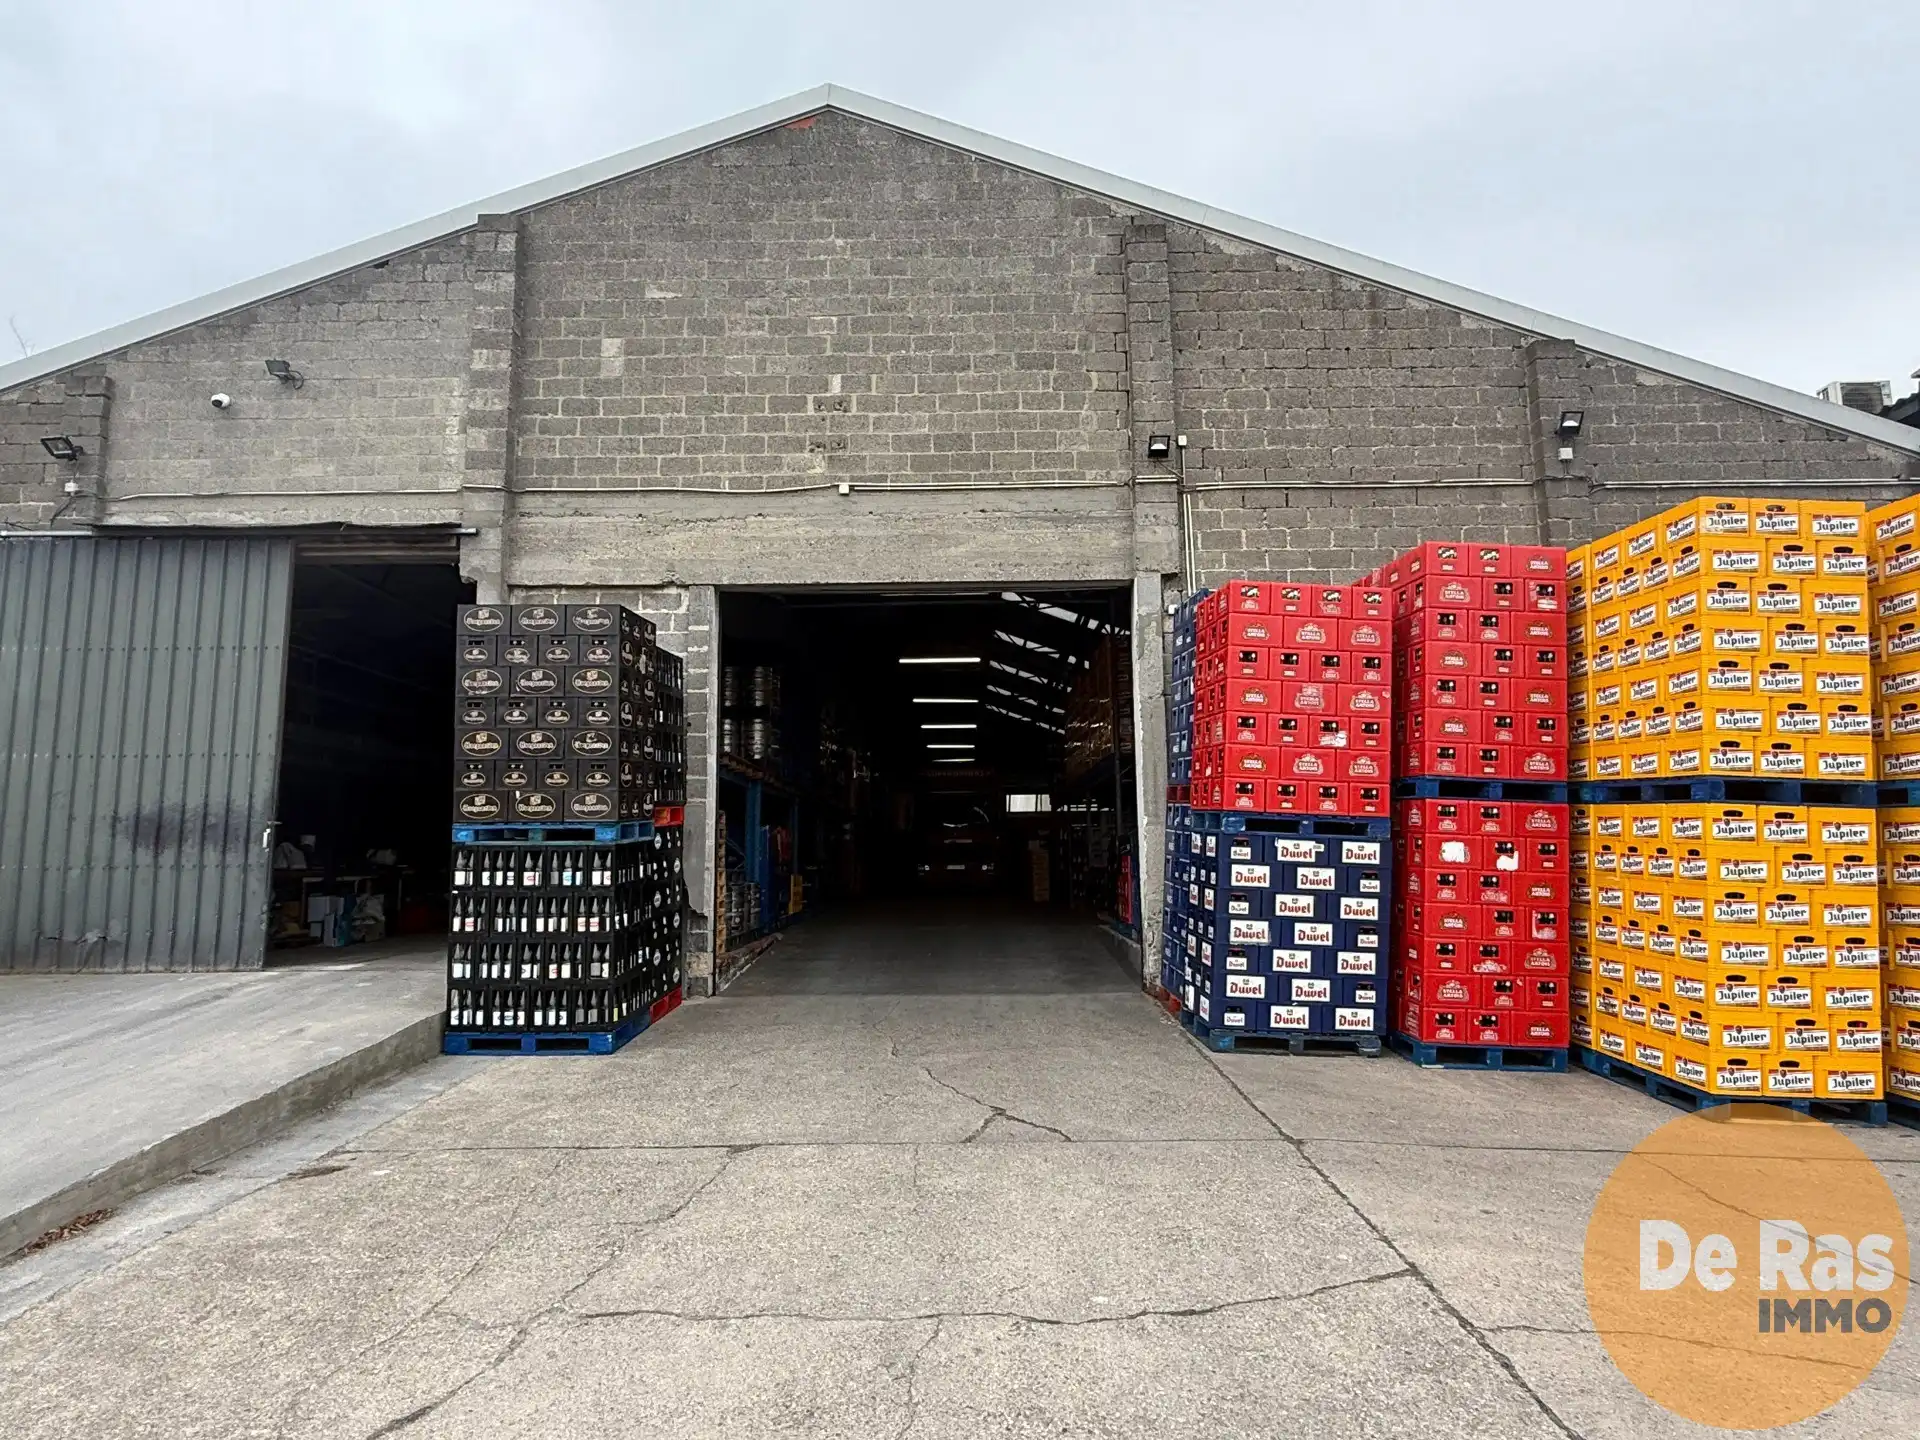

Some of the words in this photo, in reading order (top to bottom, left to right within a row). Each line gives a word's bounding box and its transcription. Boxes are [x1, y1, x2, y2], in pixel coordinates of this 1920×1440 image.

[1708, 517, 1746, 527] Jupiler
[1759, 518, 1796, 528] Jupiler
[1816, 521, 1855, 531] Jupiler
[1879, 515, 1912, 534] Jupiler
[1669, 521, 1693, 536] Jupiler
[1676, 556, 1698, 572] Jupiler
[1717, 556, 1756, 566] Jupiler
[1776, 558, 1813, 568] Jupiler
[1827, 560, 1864, 570] Jupiler
[1888, 553, 1918, 569] Jupiler
[1670, 598, 1694, 613] Jupiler
[1710, 596, 1747, 605] Jupiler
[1761, 597, 1797, 607] Jupiler
[1818, 599, 1857, 610] Jupiler
[1882, 596, 1914, 612] Jupiler
[1676, 636, 1700, 649] Jupiler
[1718, 636, 1757, 646] Jupiler
[1778, 637, 1815, 647] Jupiler
[1829, 639, 1866, 649] Jupiler
[1672, 676, 1696, 688] Jupiler
[1711, 675, 1748, 684] Jupiler
[1763, 676, 1800, 686] Jupiler
[1820, 679, 1859, 689] Jupiler
[1677, 714, 1701, 726] Jupiler
[1720, 716, 1759, 726] Jupiler
[1780, 717, 1818, 727] Jupiler
[1831, 719, 1868, 729] Jupiler
[1672, 756, 1697, 766] Jupiler
[1713, 755, 1750, 765] Jupiler
[1764, 757, 1802, 767] Jupiler
[1822, 760, 1862, 770] Jupiler
[1674, 824, 1699, 834] Jupiler
[1716, 824, 1753, 835] Jupiler
[1768, 827, 1804, 836] Jupiler
[1826, 829, 1865, 839] Jupiler
[1281, 849, 1313, 859] Duvel
[1346, 852, 1377, 861] Duvel
[1682, 863, 1705, 873] Jupiler
[1724, 866, 1764, 877] Jupiler
[1786, 868, 1824, 878] Jupiler
[1236, 873, 1267, 883] Duvel
[1837, 870, 1874, 880] Jupiler
[1301, 875, 1332, 886] Duvel
[1280, 903, 1311, 913] Duvel
[1344, 906, 1376, 916] Duvel
[1676, 903, 1701, 913] Jupiler
[1718, 908, 1754, 918] Jupiler
[1769, 909, 1806, 919] Jupiler
[1828, 910, 1867, 922] Jupiler
[1234, 929, 1266, 939] Duvel
[1298, 931, 1330, 942] Duvel
[1682, 944, 1707, 954] Jupiler
[1726, 949, 1765, 960] Jupiler
[1787, 950, 1824, 961] Jupiler
[1277, 958, 1308, 969] Duvel
[1341, 961, 1373, 971] Duvel
[1230, 984, 1262, 994] Duvel
[1296, 987, 1327, 997] Duvel
[1677, 984, 1702, 994] Jupiler
[1719, 990, 1756, 1000] Jupiler
[1771, 992, 1808, 1002] Jupiler
[1830, 994, 1869, 1004] Jupiler
[1274, 1014, 1306, 1024] Duvel
[1339, 1017, 1371, 1027] Duvel
[1683, 1024, 1708, 1036] Jupiler
[1727, 1032, 1766, 1043] Jupiler
[1788, 1034, 1826, 1045] Jupiler
[1841, 1036, 1878, 1046] Jupiler
[1677, 1064, 1703, 1077] Jupiler
[1721, 1074, 1758, 1084] Jupiler
[1772, 1076, 1810, 1086] Jupiler
[1831, 1078, 1872, 1088] Jupiler
